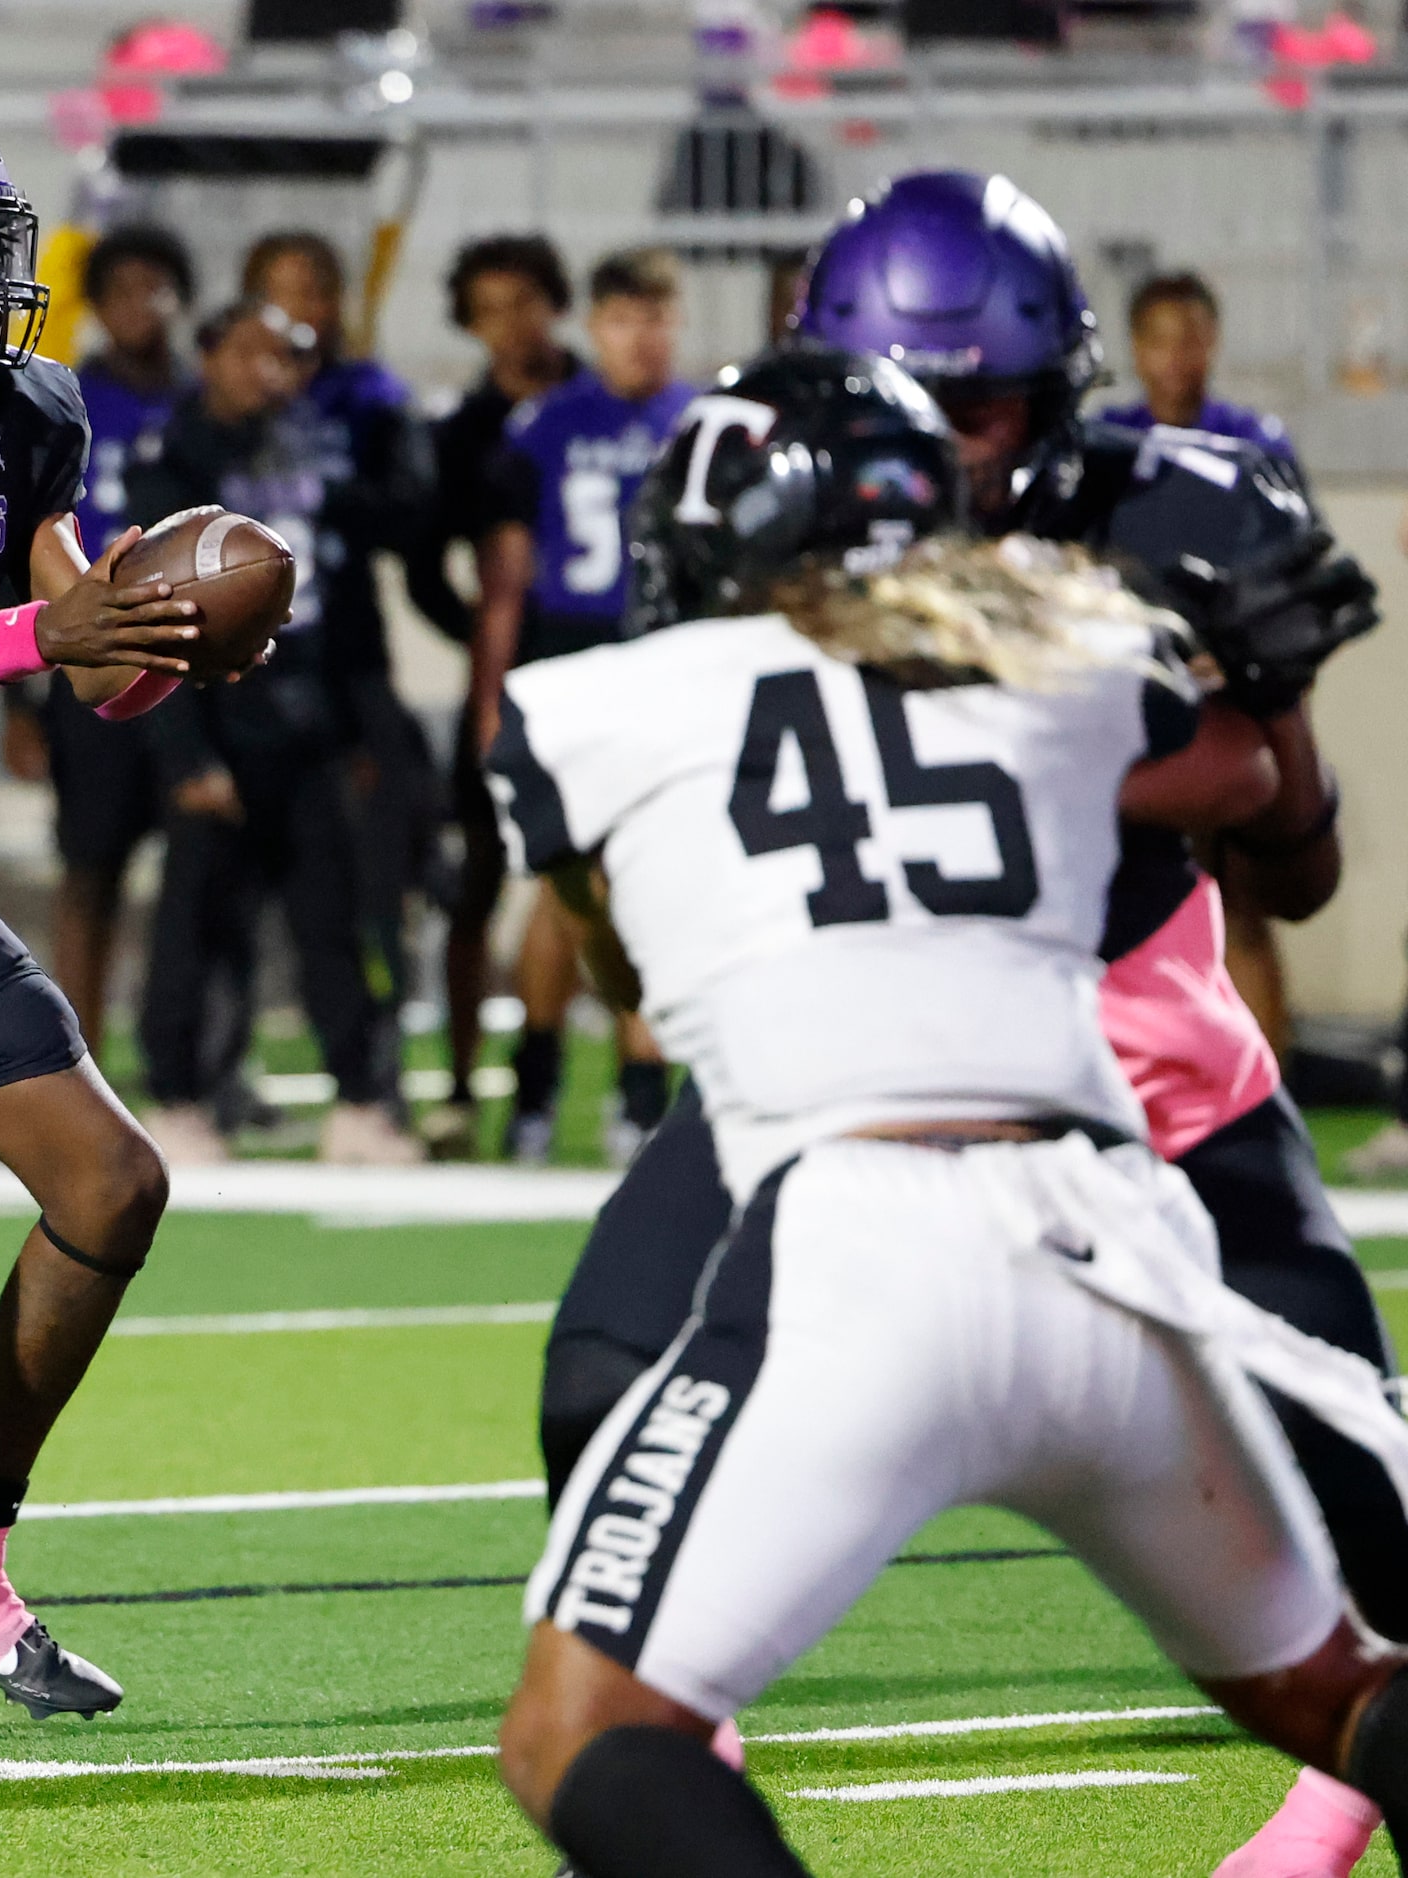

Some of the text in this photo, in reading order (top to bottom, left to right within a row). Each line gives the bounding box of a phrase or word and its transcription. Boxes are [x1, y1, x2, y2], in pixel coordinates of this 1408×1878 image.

[560, 470, 622, 593] 5
[672, 394, 779, 526] T
[728, 664, 1040, 928] 45
[553, 1373, 731, 1635] TROJANS
